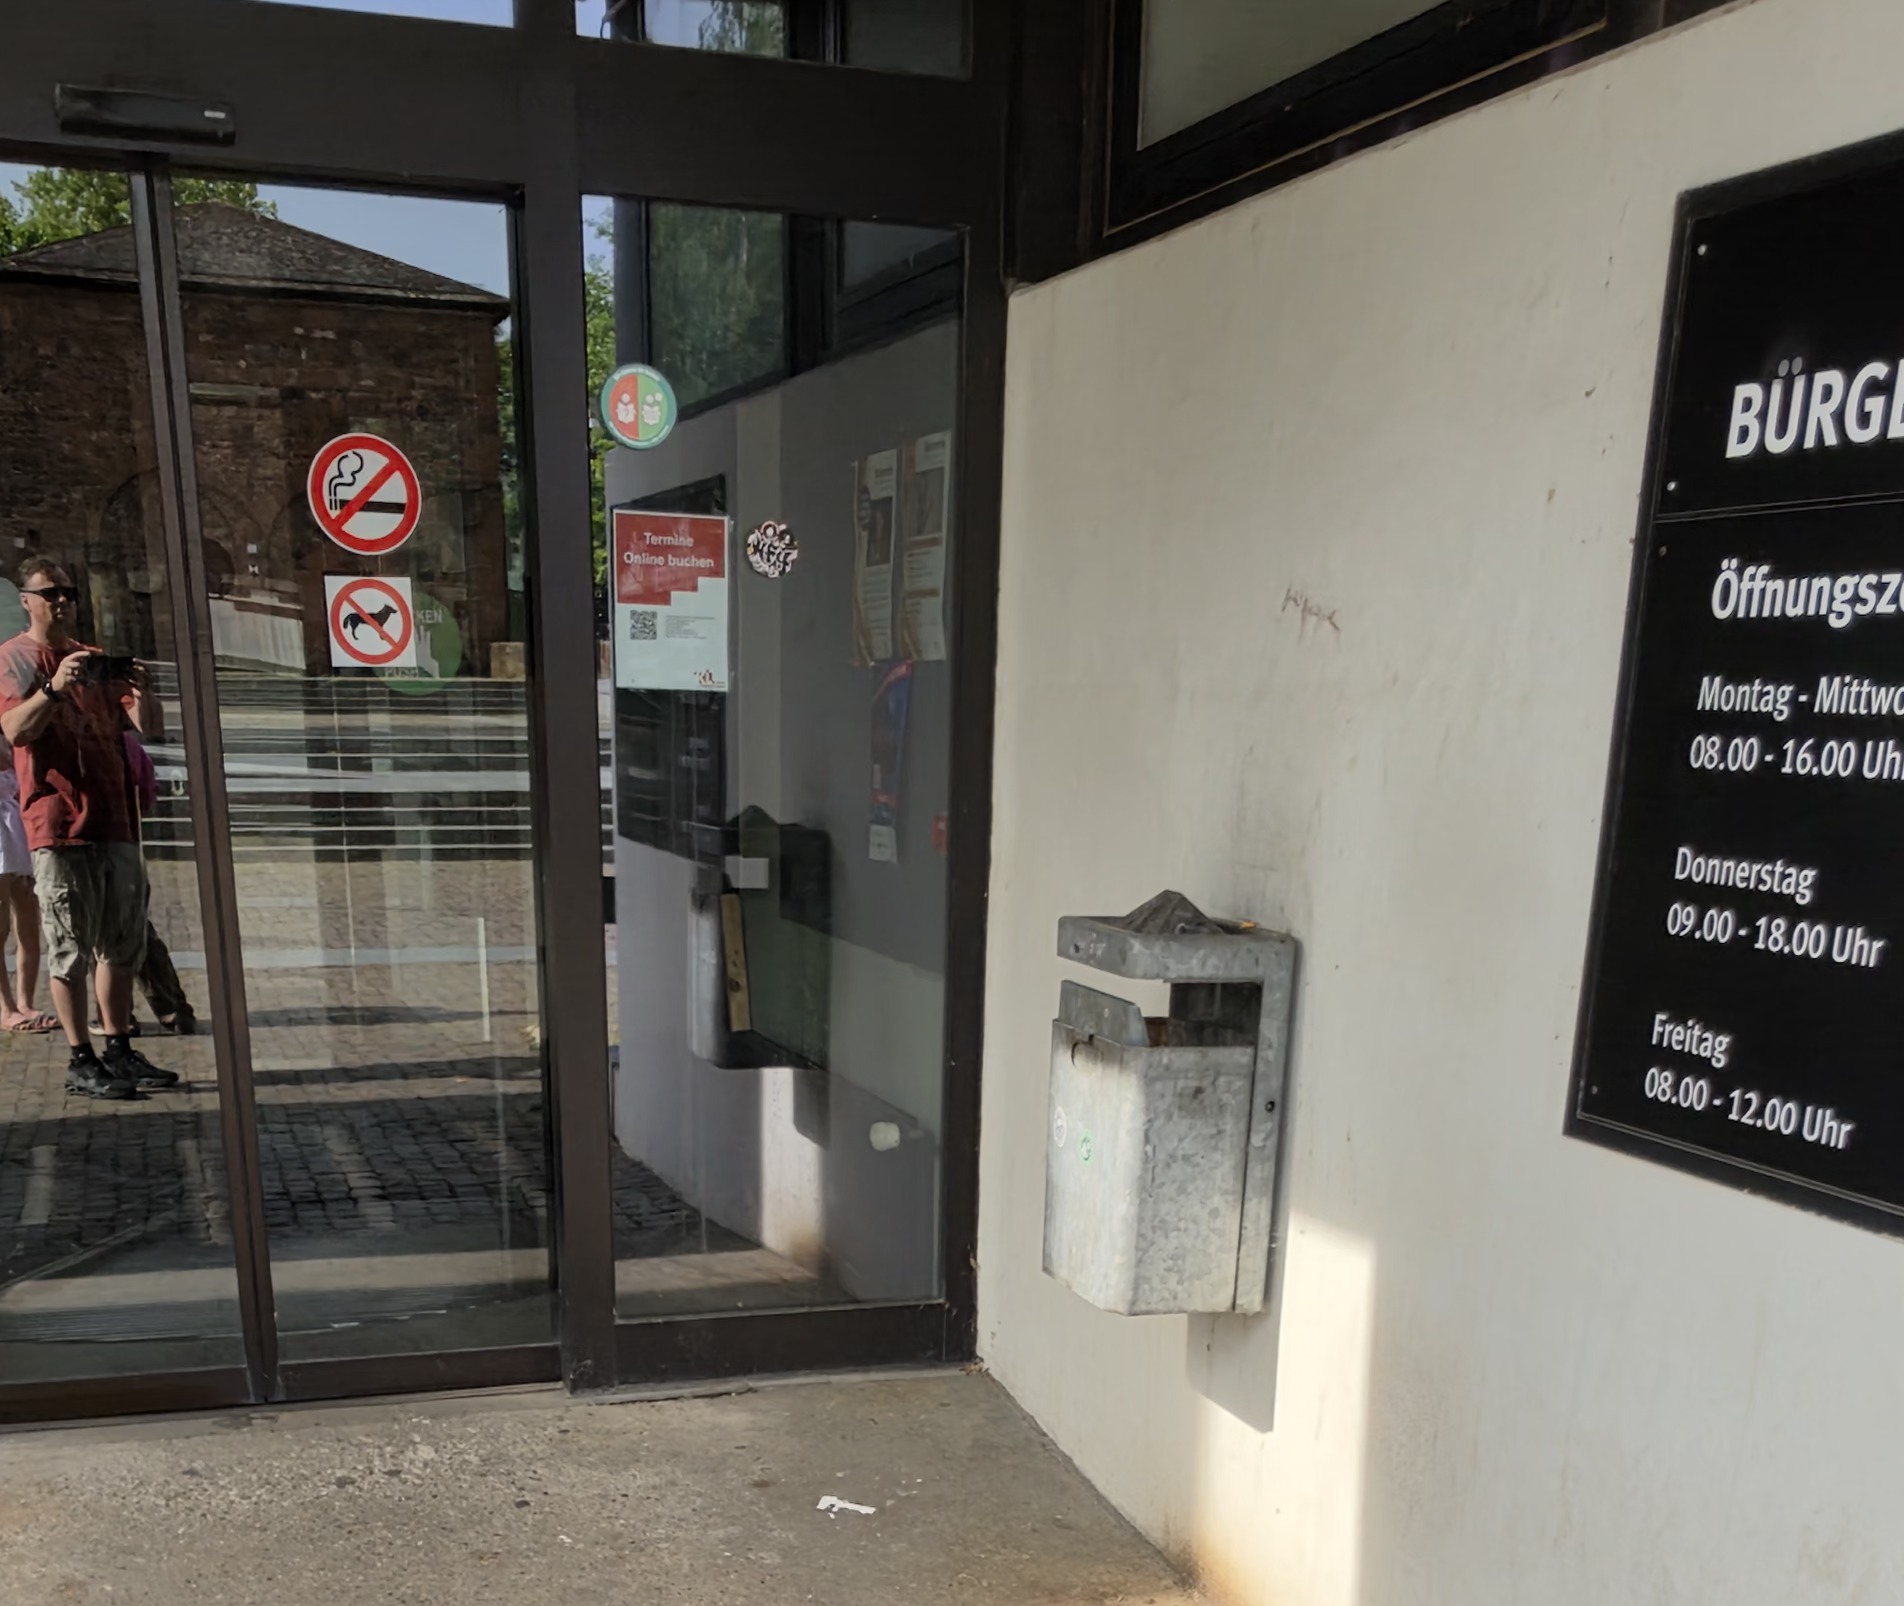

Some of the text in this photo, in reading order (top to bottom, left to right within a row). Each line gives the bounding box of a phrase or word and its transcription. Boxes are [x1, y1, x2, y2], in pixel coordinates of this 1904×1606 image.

[623, 551, 714, 568] Online buchen
[643, 532, 695, 547] Termine
[1696, 675, 1794, 722] Montag
[1689, 734, 1760, 772] 08.00
[1780, 738, 1857, 778] 16.00
[1674, 846, 1818, 903] Donnerstag
[1666, 903, 1735, 943] 09.00
[1754, 916, 1828, 959] 18.00
[1831, 925, 1885, 968] Uhr
[1651, 1013, 1732, 1068] Freitag
[1644, 1068, 1709, 1111] 08.00
[1727, 1088, 1798, 1135] 12.00
[1802, 1105, 1855, 1150] Uhr
